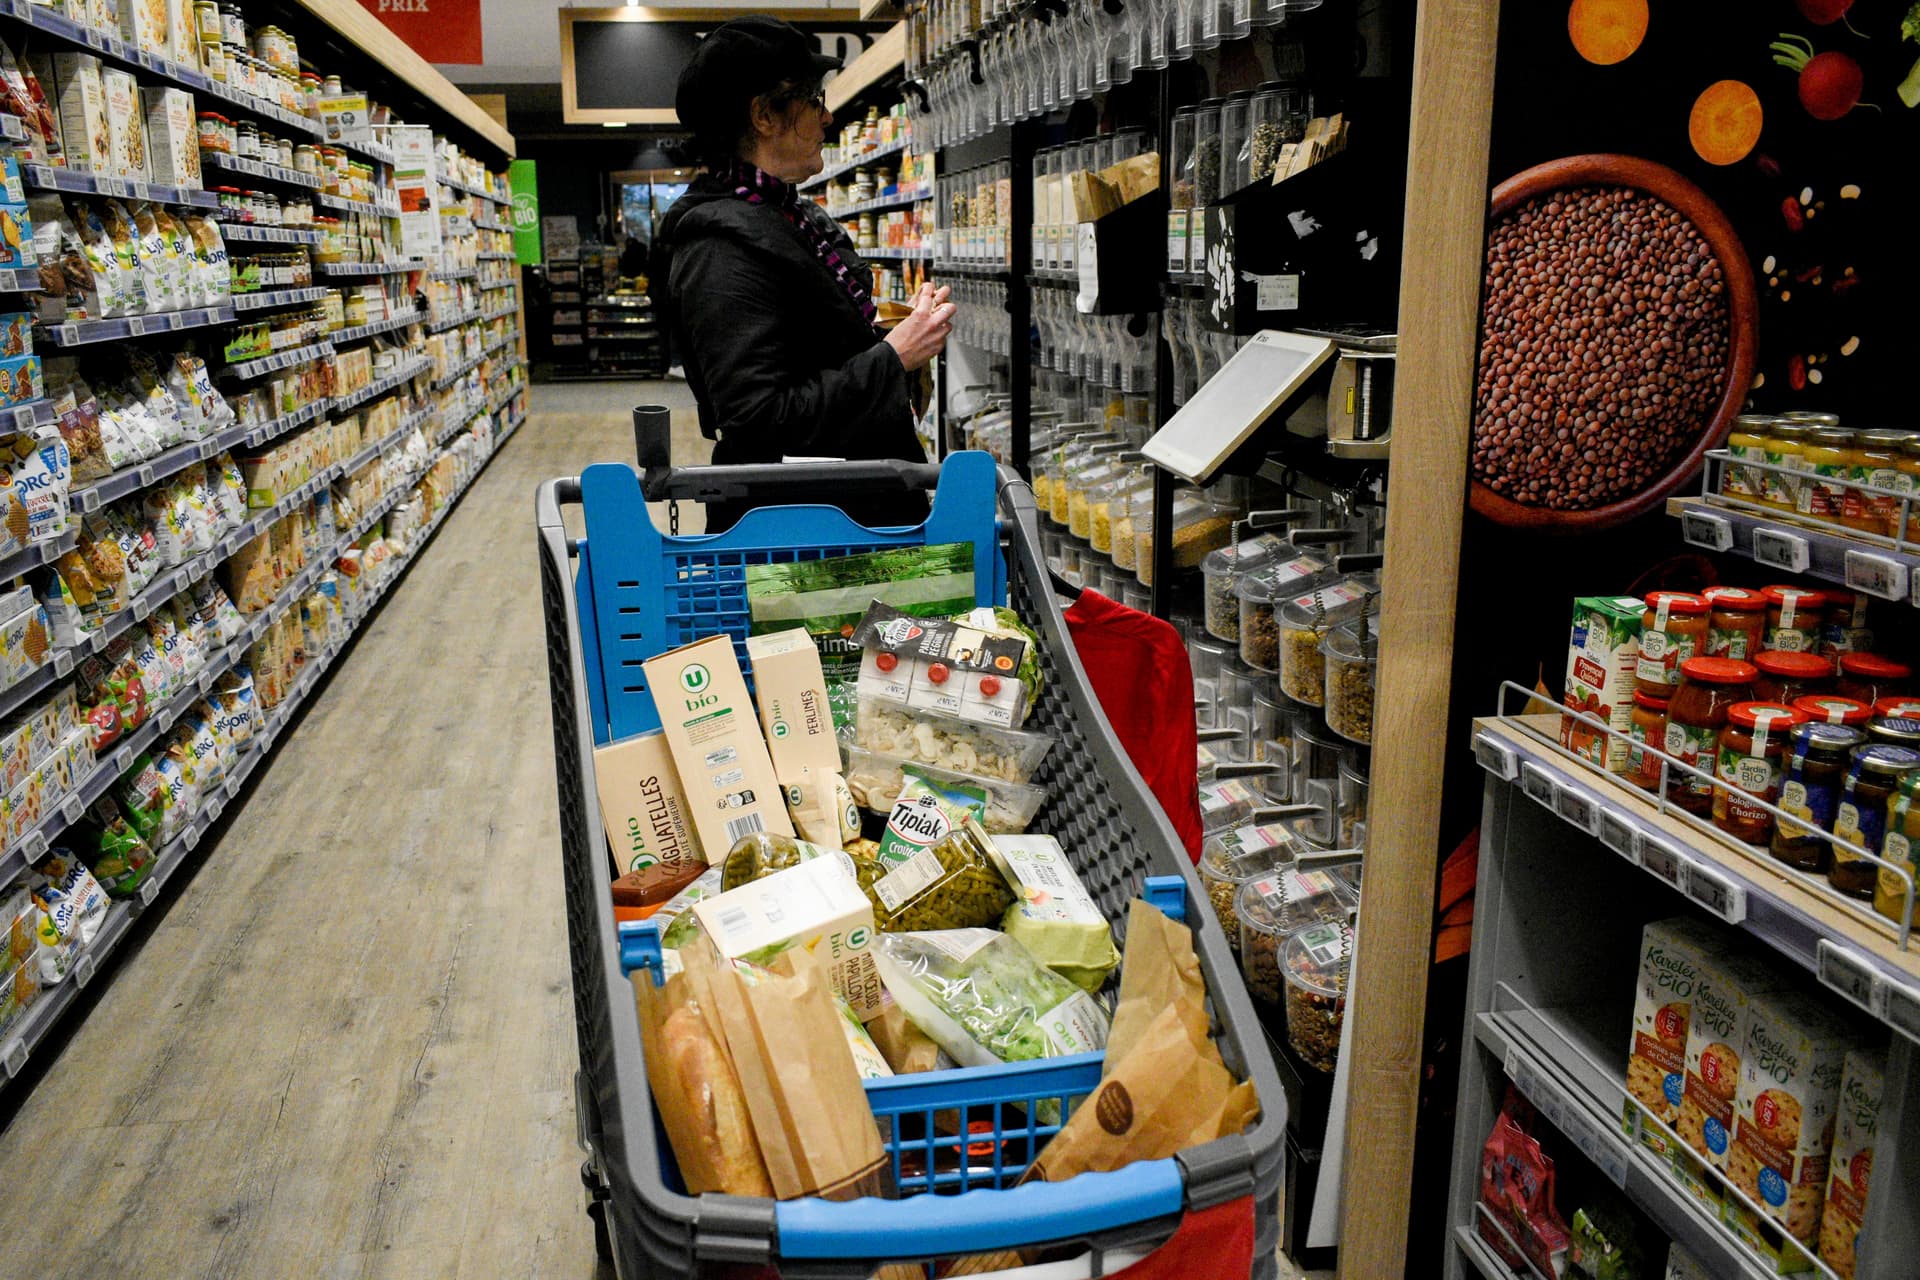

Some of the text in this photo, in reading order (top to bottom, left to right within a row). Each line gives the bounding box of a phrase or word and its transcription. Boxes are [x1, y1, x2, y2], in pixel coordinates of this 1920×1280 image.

[378, 0, 430, 12] PRIX
[514, 208, 538, 226] BIO
[685, 694, 718, 712] bio
[800, 690, 819, 736] PERLINES
[1741, 763, 1767, 773] Jardin
[666, 796, 686, 838] SUPÉRIEURE
[891, 803, 941, 839] Tipiak
[1731, 806, 1767, 820] Chorizo
[627, 817, 645, 851] bio
[831, 931, 844, 960] bio
[846, 956, 864, 1002] PAPILLON
[861, 951, 881, 1010] MINI NŒUDS
[1054, 1021, 1077, 1049] BIO
